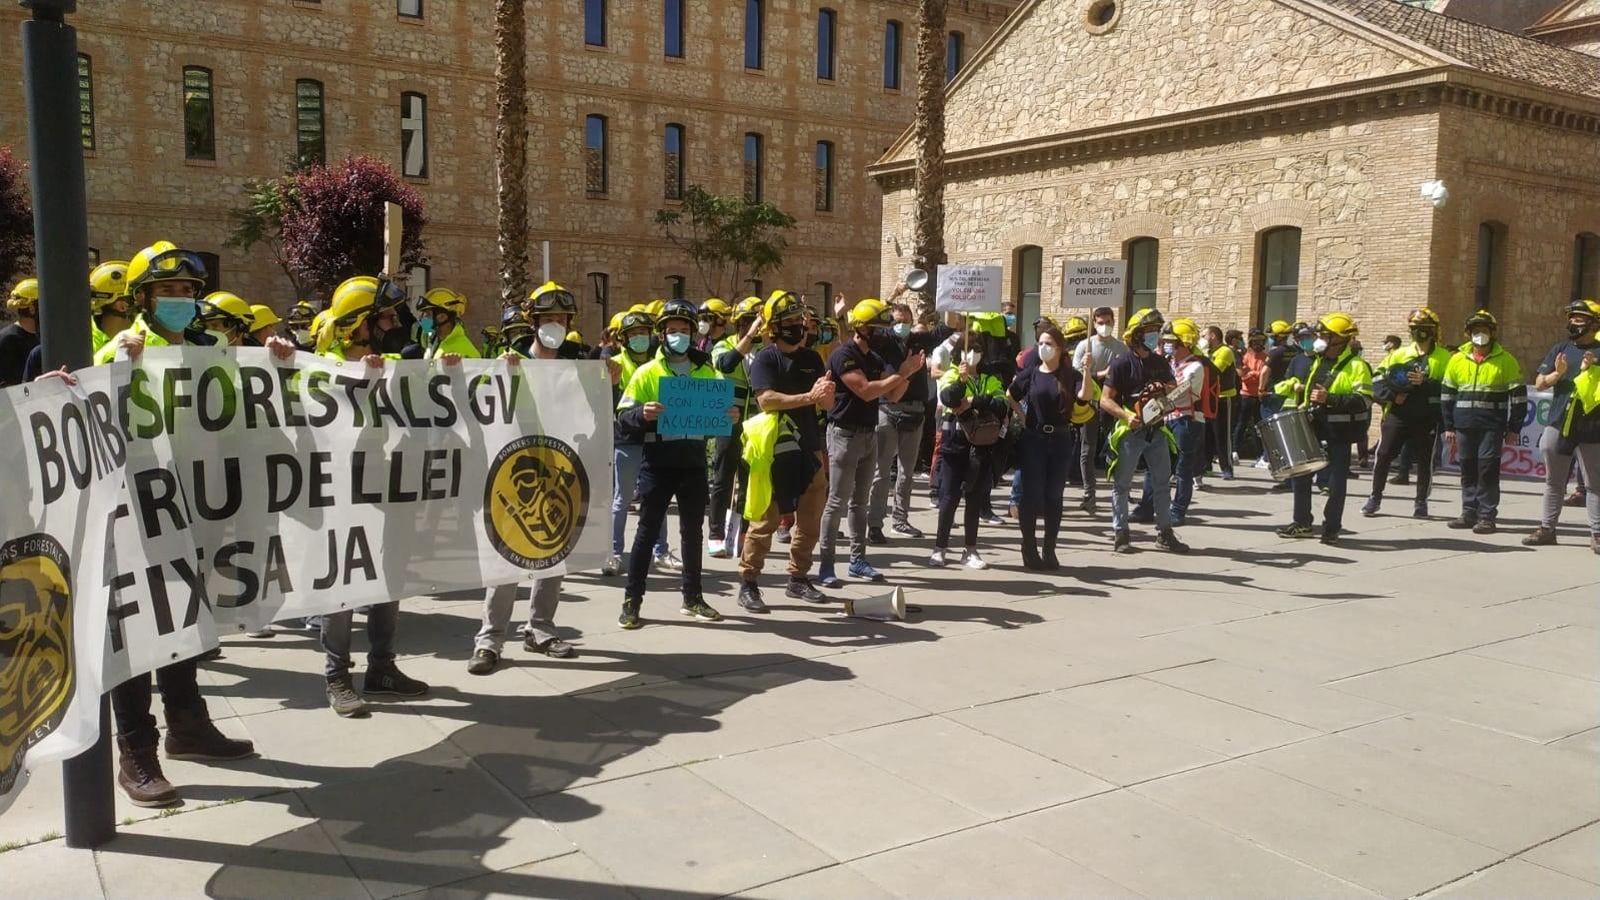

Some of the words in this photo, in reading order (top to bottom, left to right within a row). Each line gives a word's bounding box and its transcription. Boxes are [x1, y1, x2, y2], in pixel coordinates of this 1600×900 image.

[1104, 266, 1115, 274] ES
[1069, 276, 1087, 286] POT
[1087, 276, 1121, 286] QUEDAR
[671, 380, 727, 392] CUMPLAN
[163, 365, 458, 436] FORESTALS
[467, 373, 520, 426] GV
[667, 397, 692, 408] CON
[702, 399, 725, 409] LOS
[662, 415, 729, 429] ACUERDOS
[265, 451, 335, 514] DE
[350, 448, 462, 504] LLEI
[0, 543, 18, 562] RS
[23, 539, 64, 565] FORESTALS
[312, 525, 378, 590] JA
[27, 719, 52, 745] LEY
